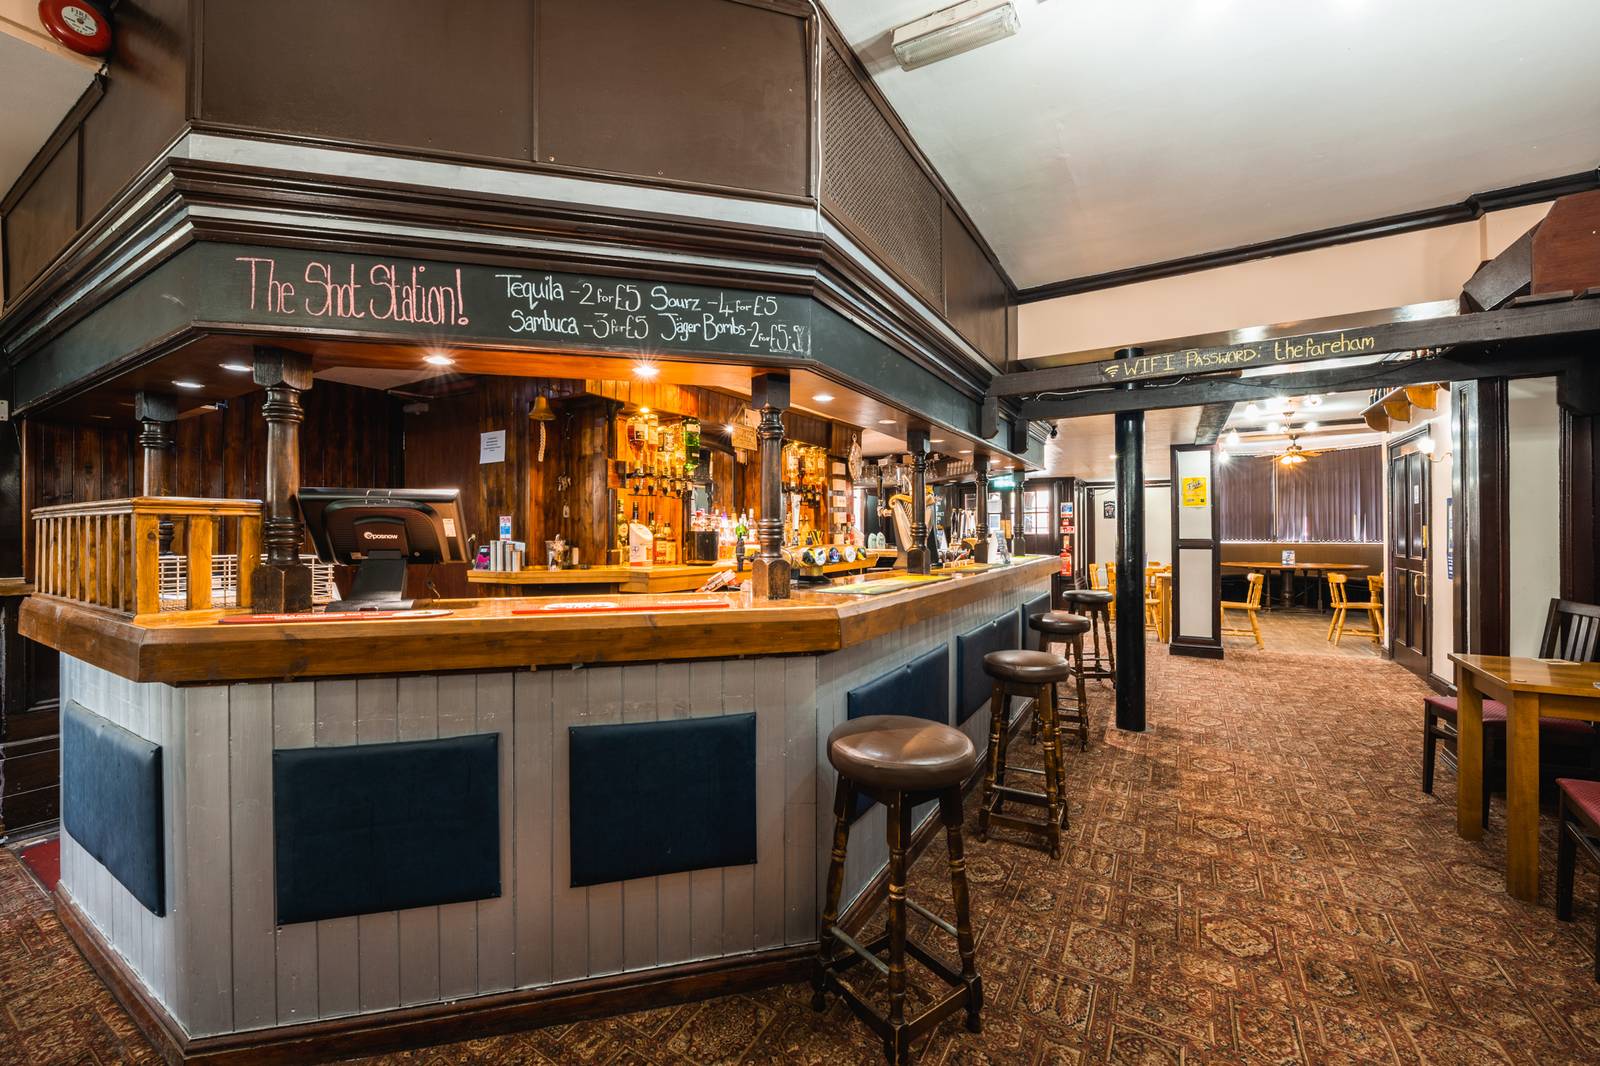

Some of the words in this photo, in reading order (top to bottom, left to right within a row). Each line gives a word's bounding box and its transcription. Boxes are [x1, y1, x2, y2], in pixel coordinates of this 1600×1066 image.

[235, 257, 296, 314] The
[304, 262, 365, 319] Shot
[369, 264, 470, 327] Station!
[494, 274, 565, 310] Tequila
[597, 288, 614, 303] for
[615, 284, 642, 312] £5
[650, 285, 702, 311] Sourz
[735, 300, 752, 313] for
[753, 295, 778, 316] £5
[508, 309, 580, 336] Sambuca
[626, 314, 649, 340] £5
[658, 312, 702, 342] Jäger
[702, 312, 747, 341] Bombs
[1123, 353, 1176, 377] WIFI
